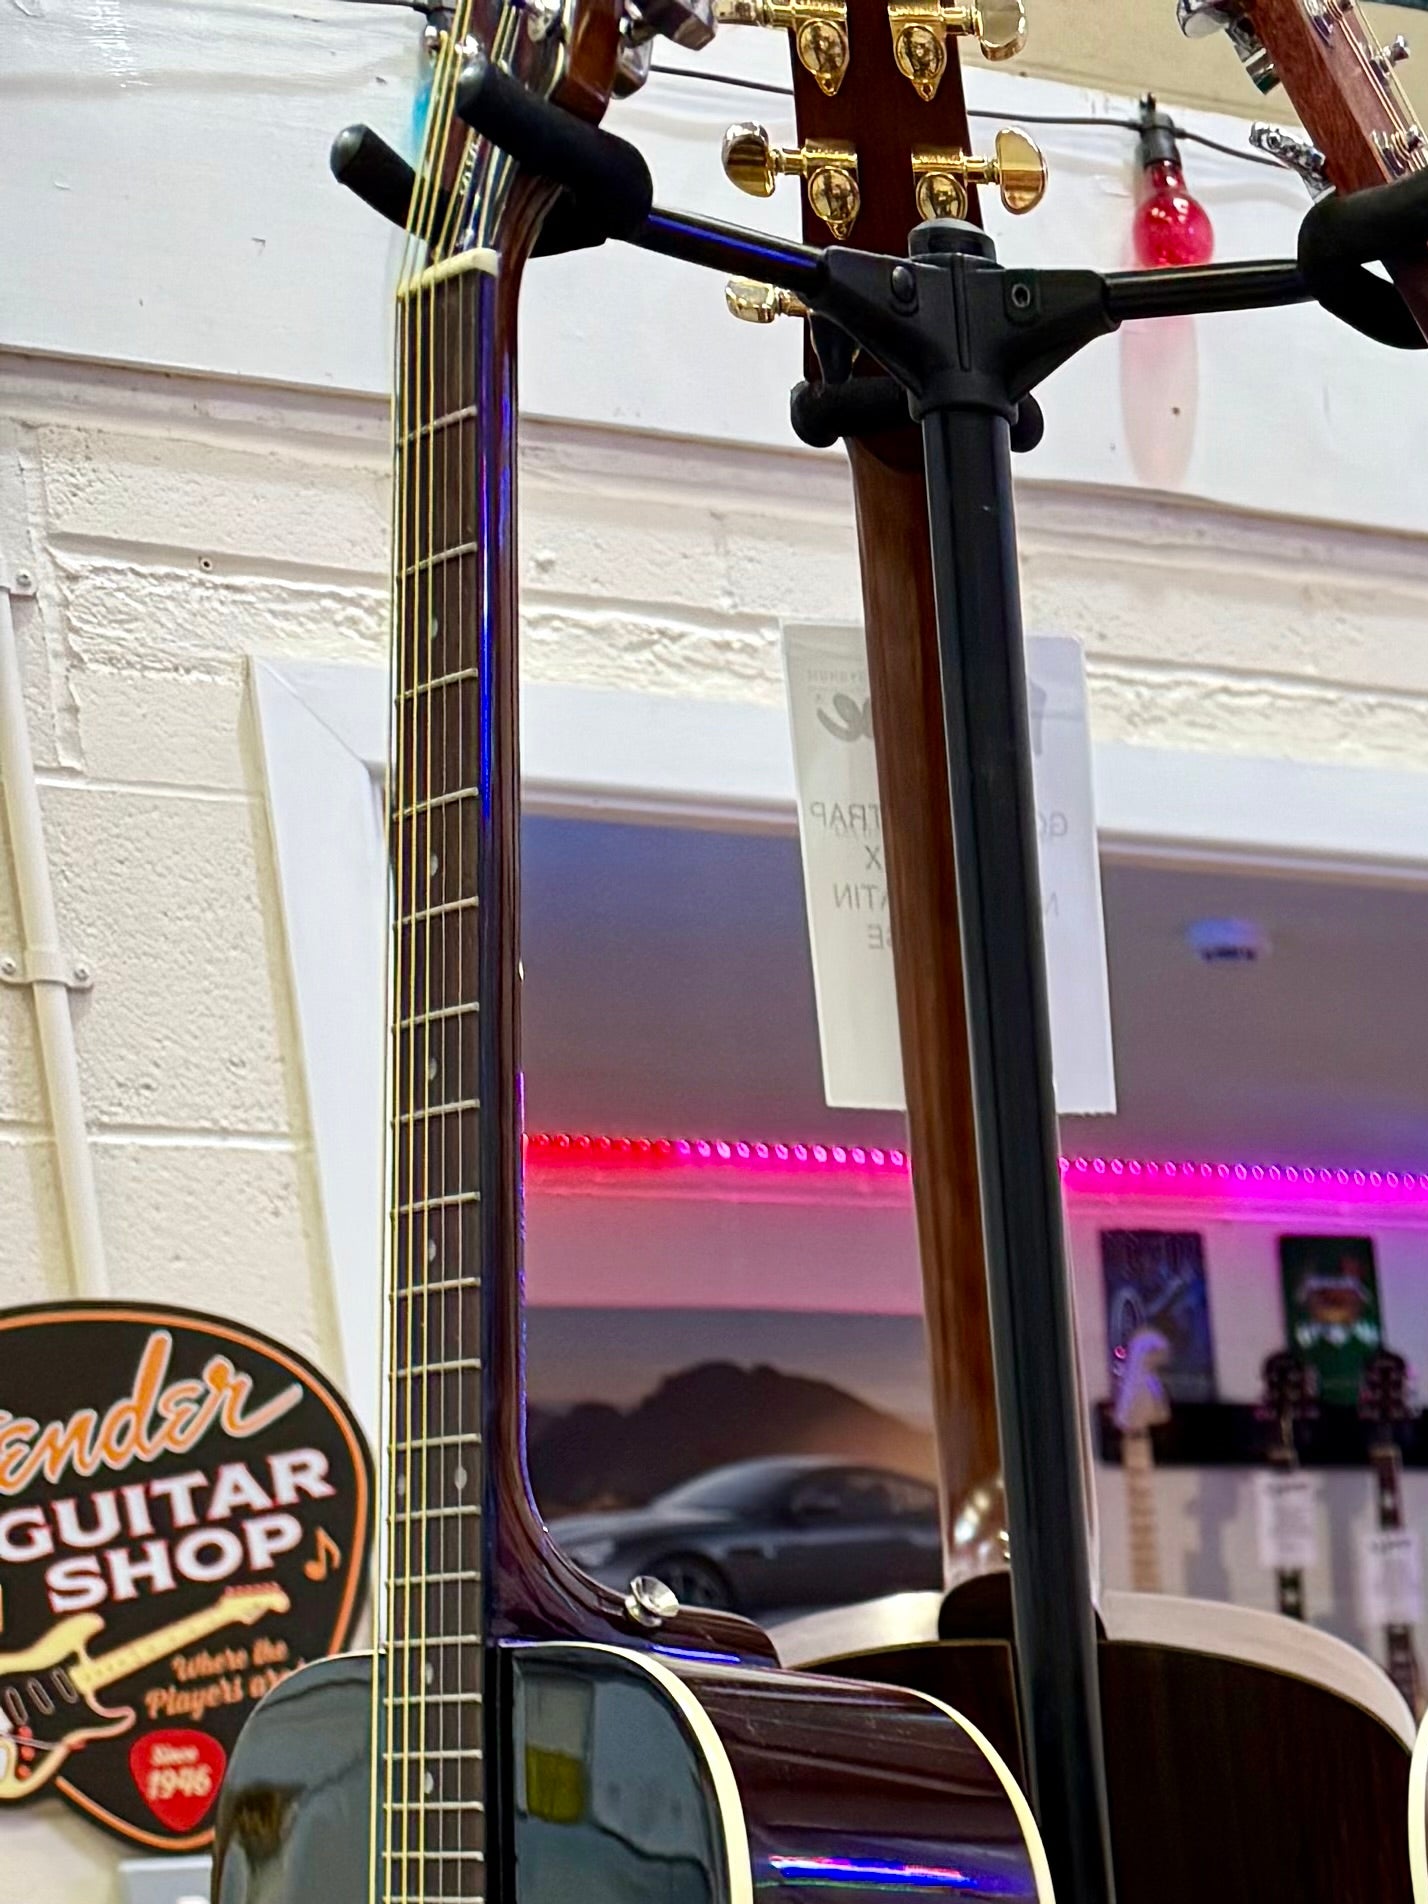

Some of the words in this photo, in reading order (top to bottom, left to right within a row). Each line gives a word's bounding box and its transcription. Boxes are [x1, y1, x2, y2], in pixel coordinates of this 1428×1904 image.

[0, 1331, 303, 1494] ender
[0, 1448, 336, 1562] GUITAR
[45, 1513, 302, 1613] SHOP
[171, 1648, 248, 1682] Where
[252, 1637, 288, 1665] the
[144, 1676, 244, 1720] Players
[147, 1764, 213, 1800] 1946
